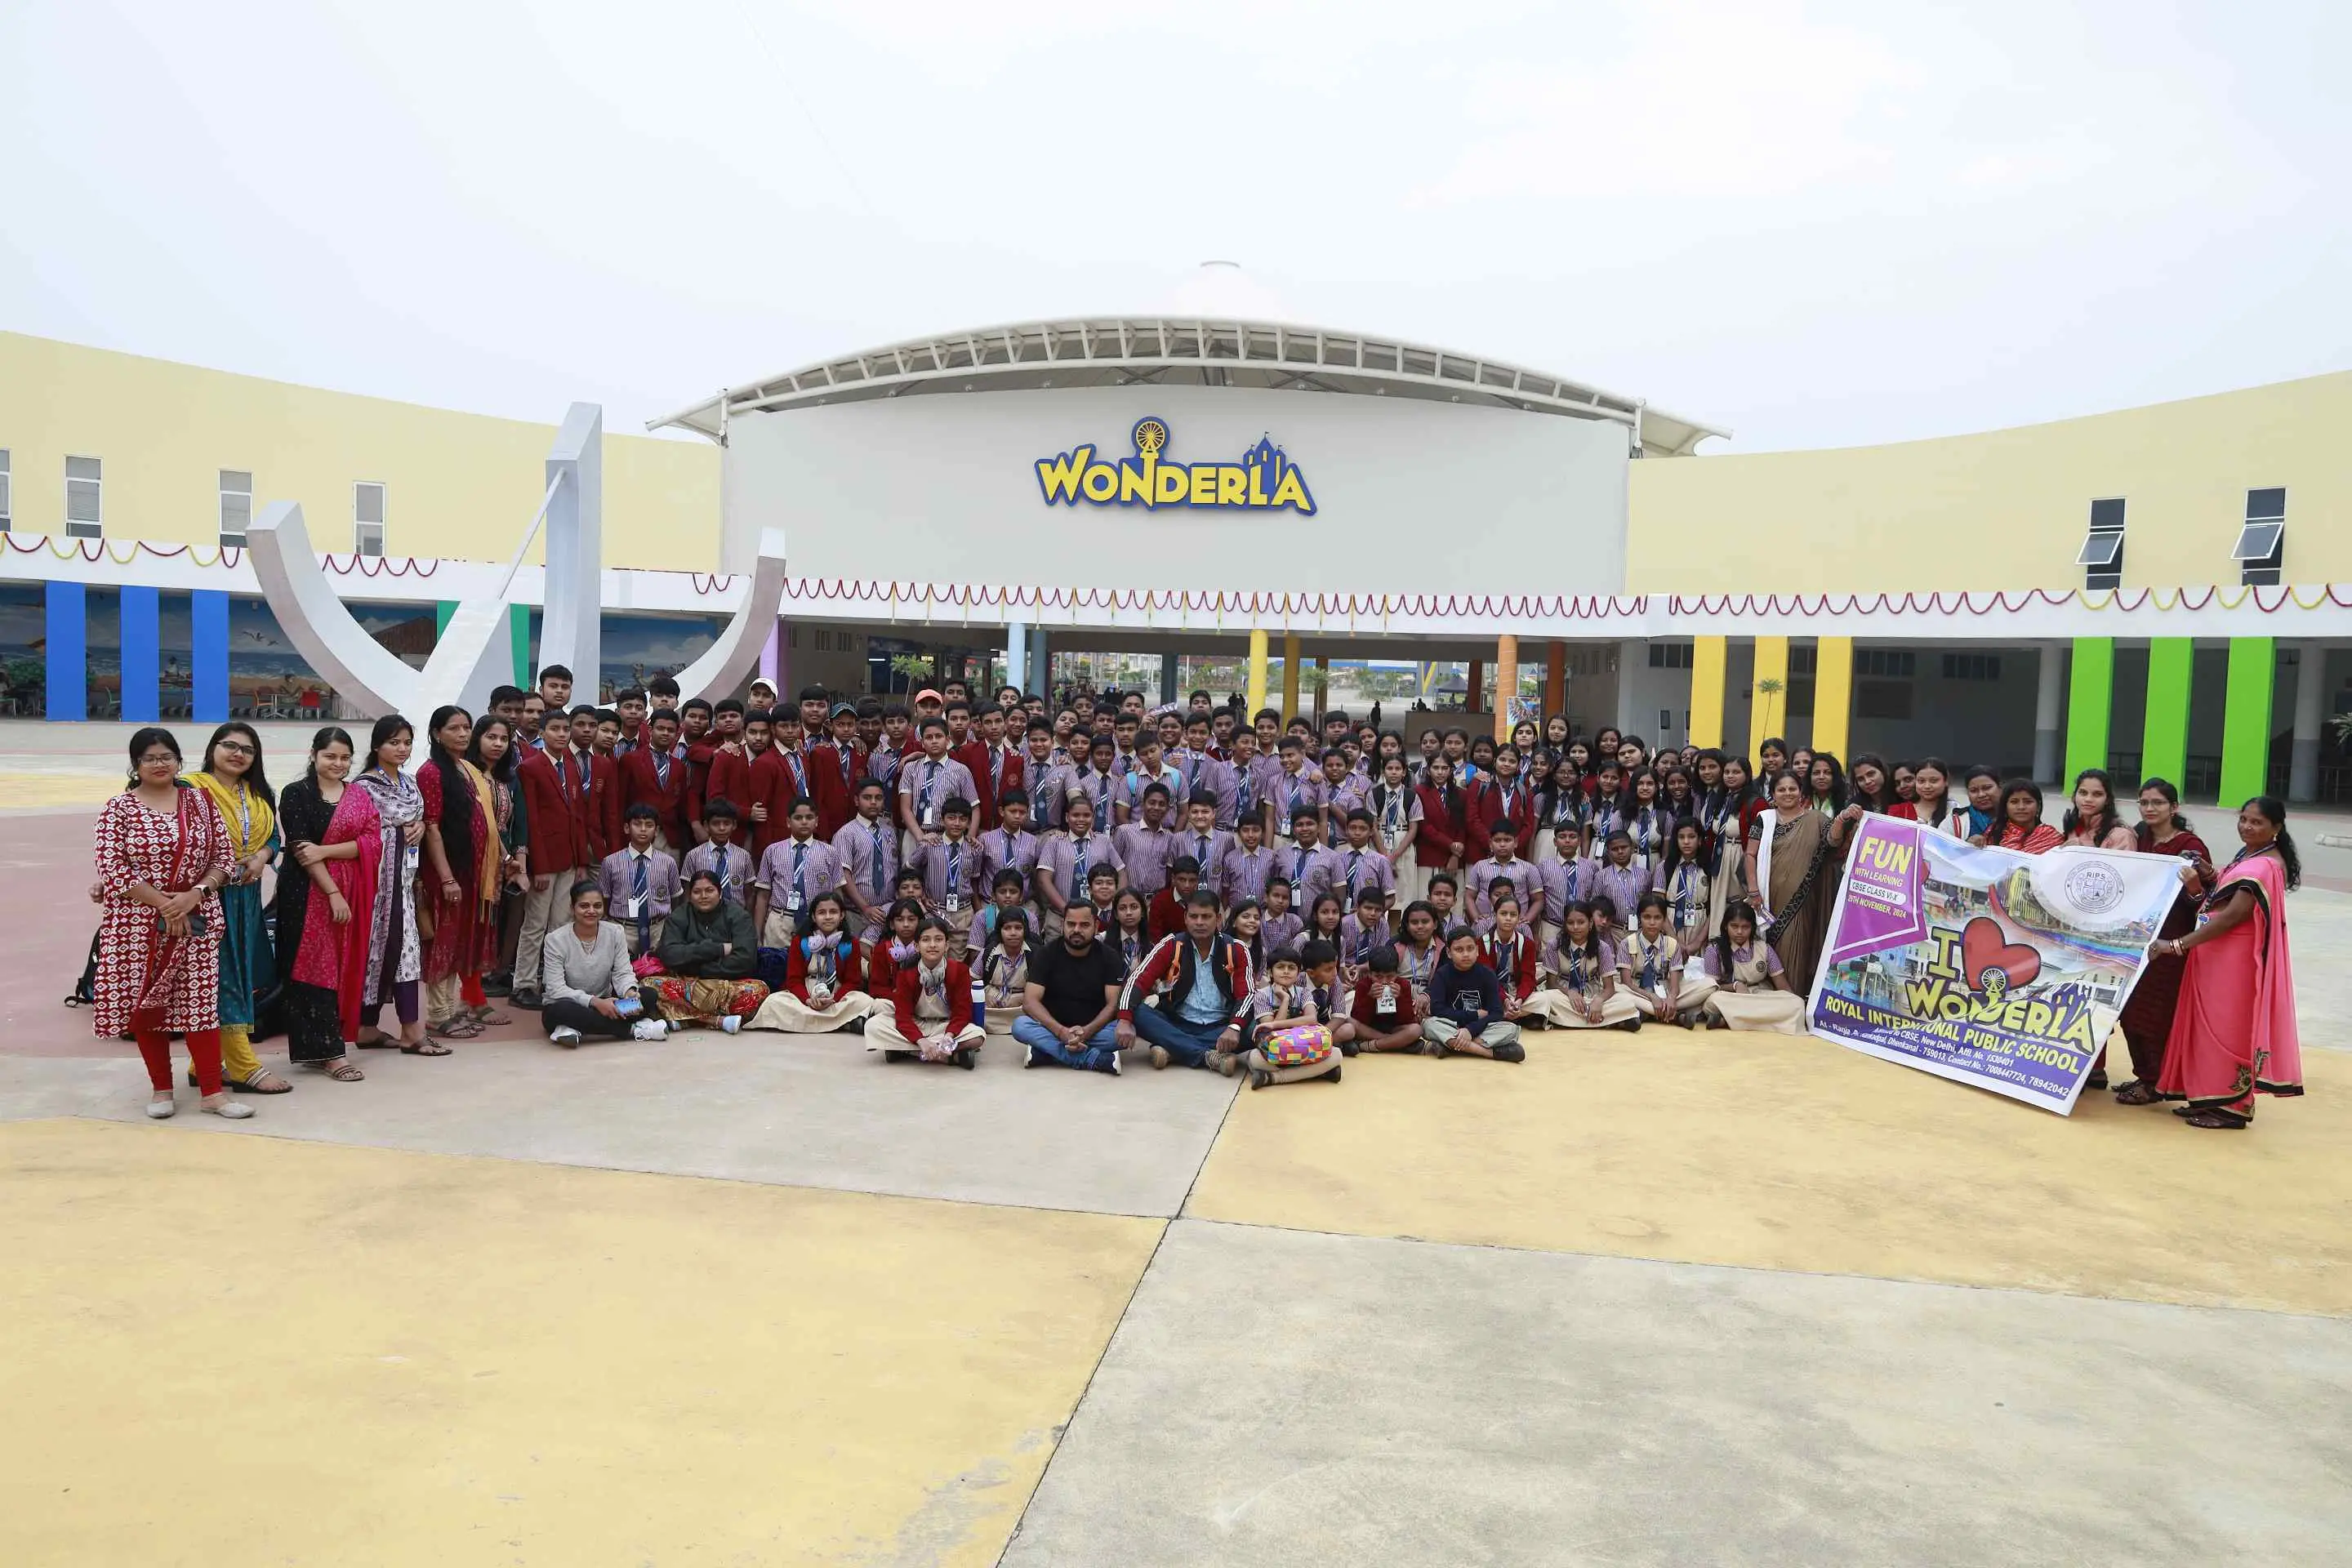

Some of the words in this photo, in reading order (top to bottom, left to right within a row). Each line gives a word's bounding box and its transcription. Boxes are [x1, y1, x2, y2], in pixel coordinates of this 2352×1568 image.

[1035, 439, 1315, 513] WONDERLA
[1858, 836, 1913, 875] FUN
[1855, 866, 1869, 878] WITH
[1869, 871, 1904, 887] LEARNING
[2087, 871, 2105, 880] RIPS
[1867, 886, 1886, 898] CLASS
[1892, 908, 1908, 919] 2024
[1928, 927, 1960, 980] I
[1825, 996, 1864, 1021] ROYAL
[1963, 1028, 2016, 1054] PUBLIC
[2016, 1043, 2079, 1074] SCHOOL
[1887, 1036, 1919, 1052] Dhenkanal
[1900, 1031, 1919, 1043] CBSE,
[1921, 1036, 1936, 1046] New
[1936, 1040, 1956, 1054] Delhi,
